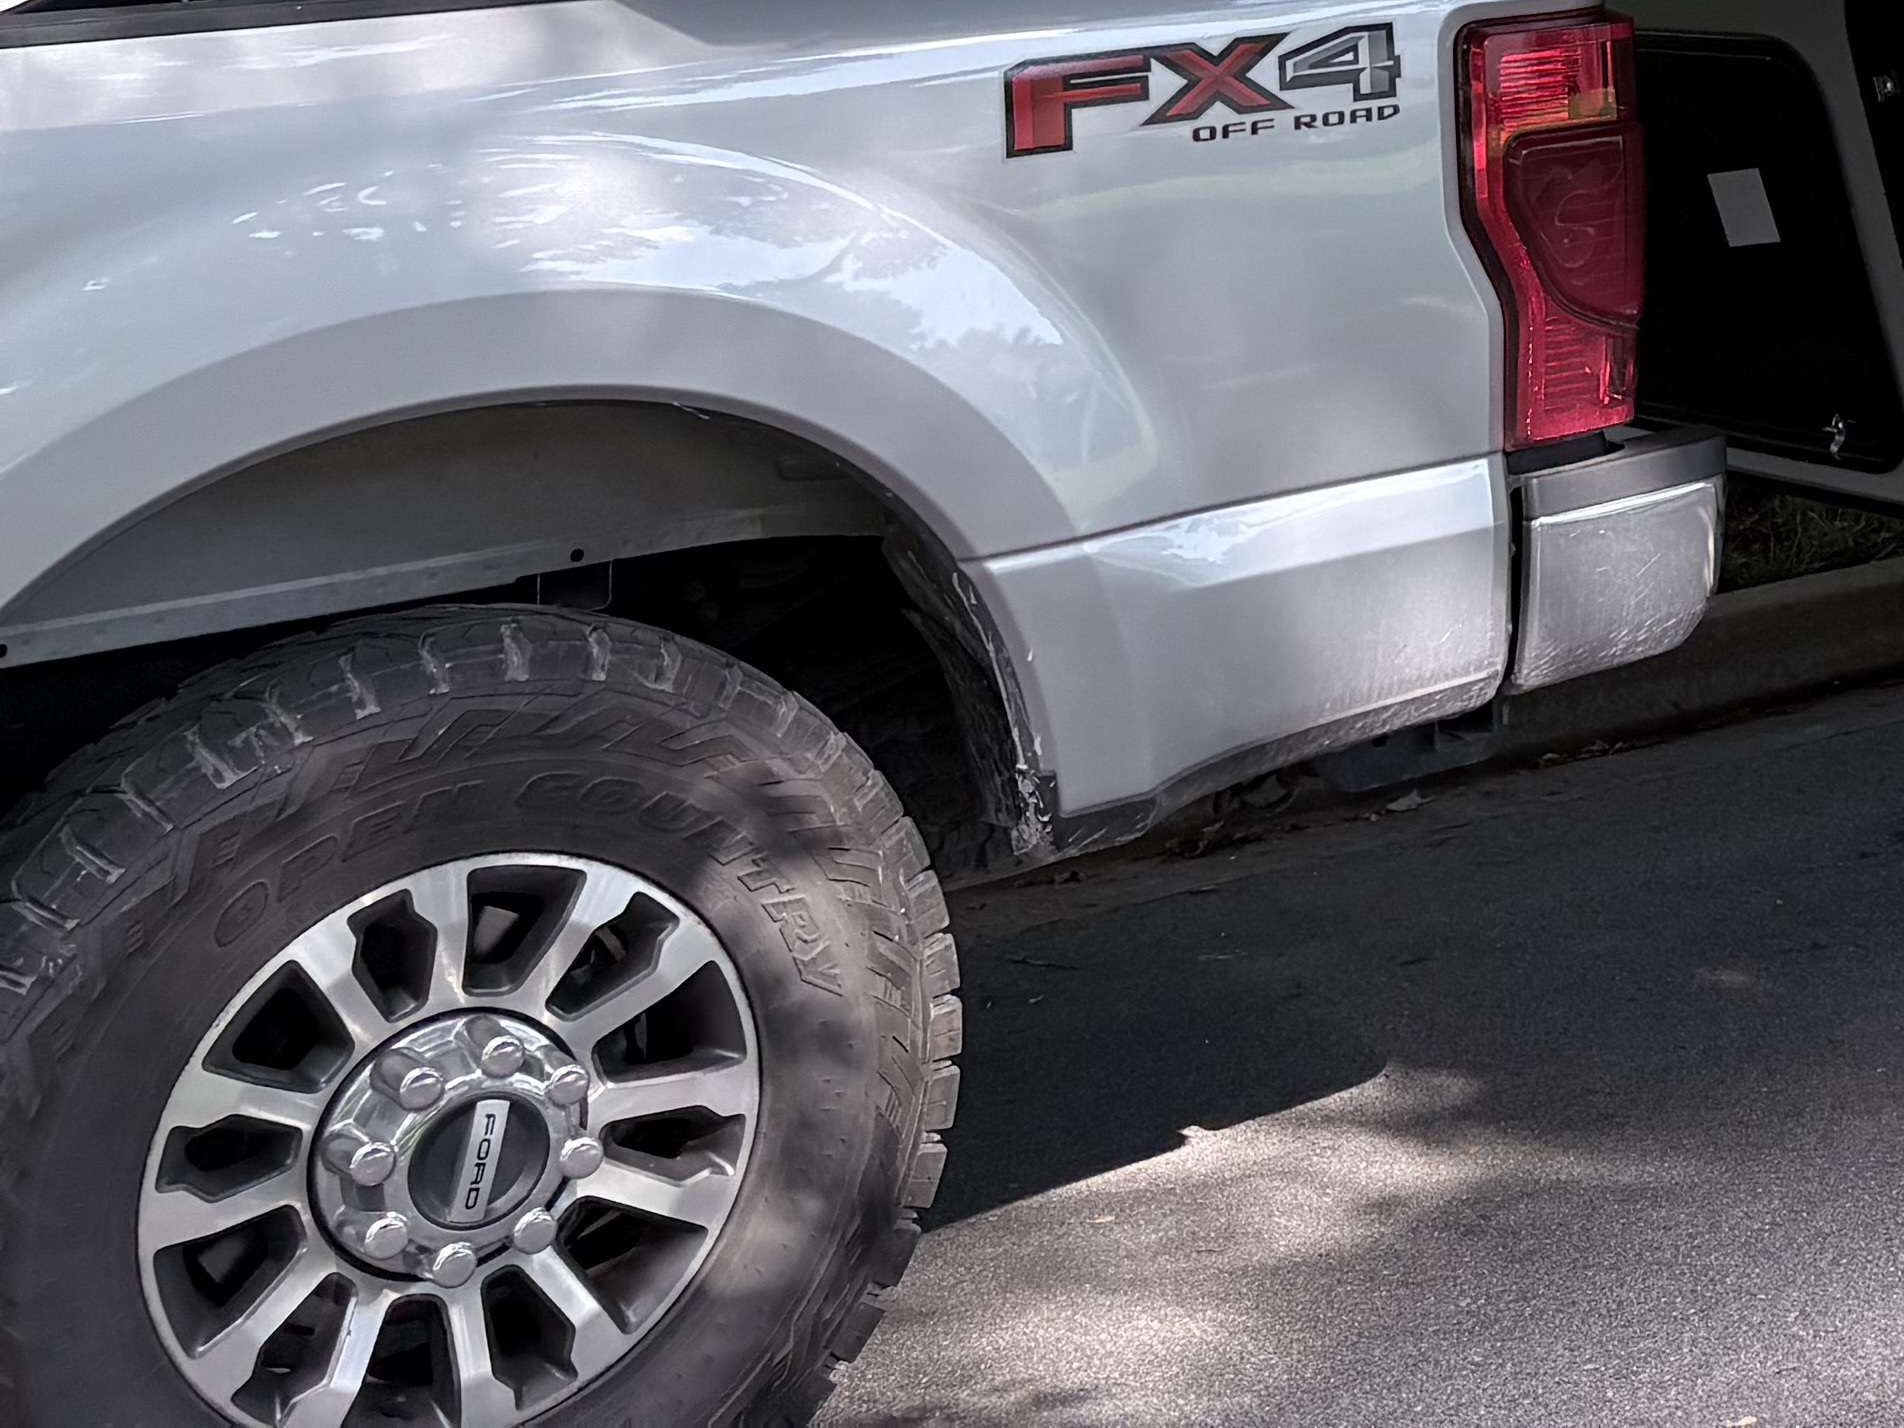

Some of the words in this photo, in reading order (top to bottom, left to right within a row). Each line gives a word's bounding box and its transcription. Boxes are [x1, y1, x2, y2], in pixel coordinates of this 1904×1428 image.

[1004, 21, 1402, 159] FX4
[1192, 118, 1276, 143] OFF
[1293, 103, 1401, 131] ROAD
[213, 777, 490, 949] OPEN
[514, 770, 846, 998] COUNTRY
[465, 1113, 497, 1210] FORD
